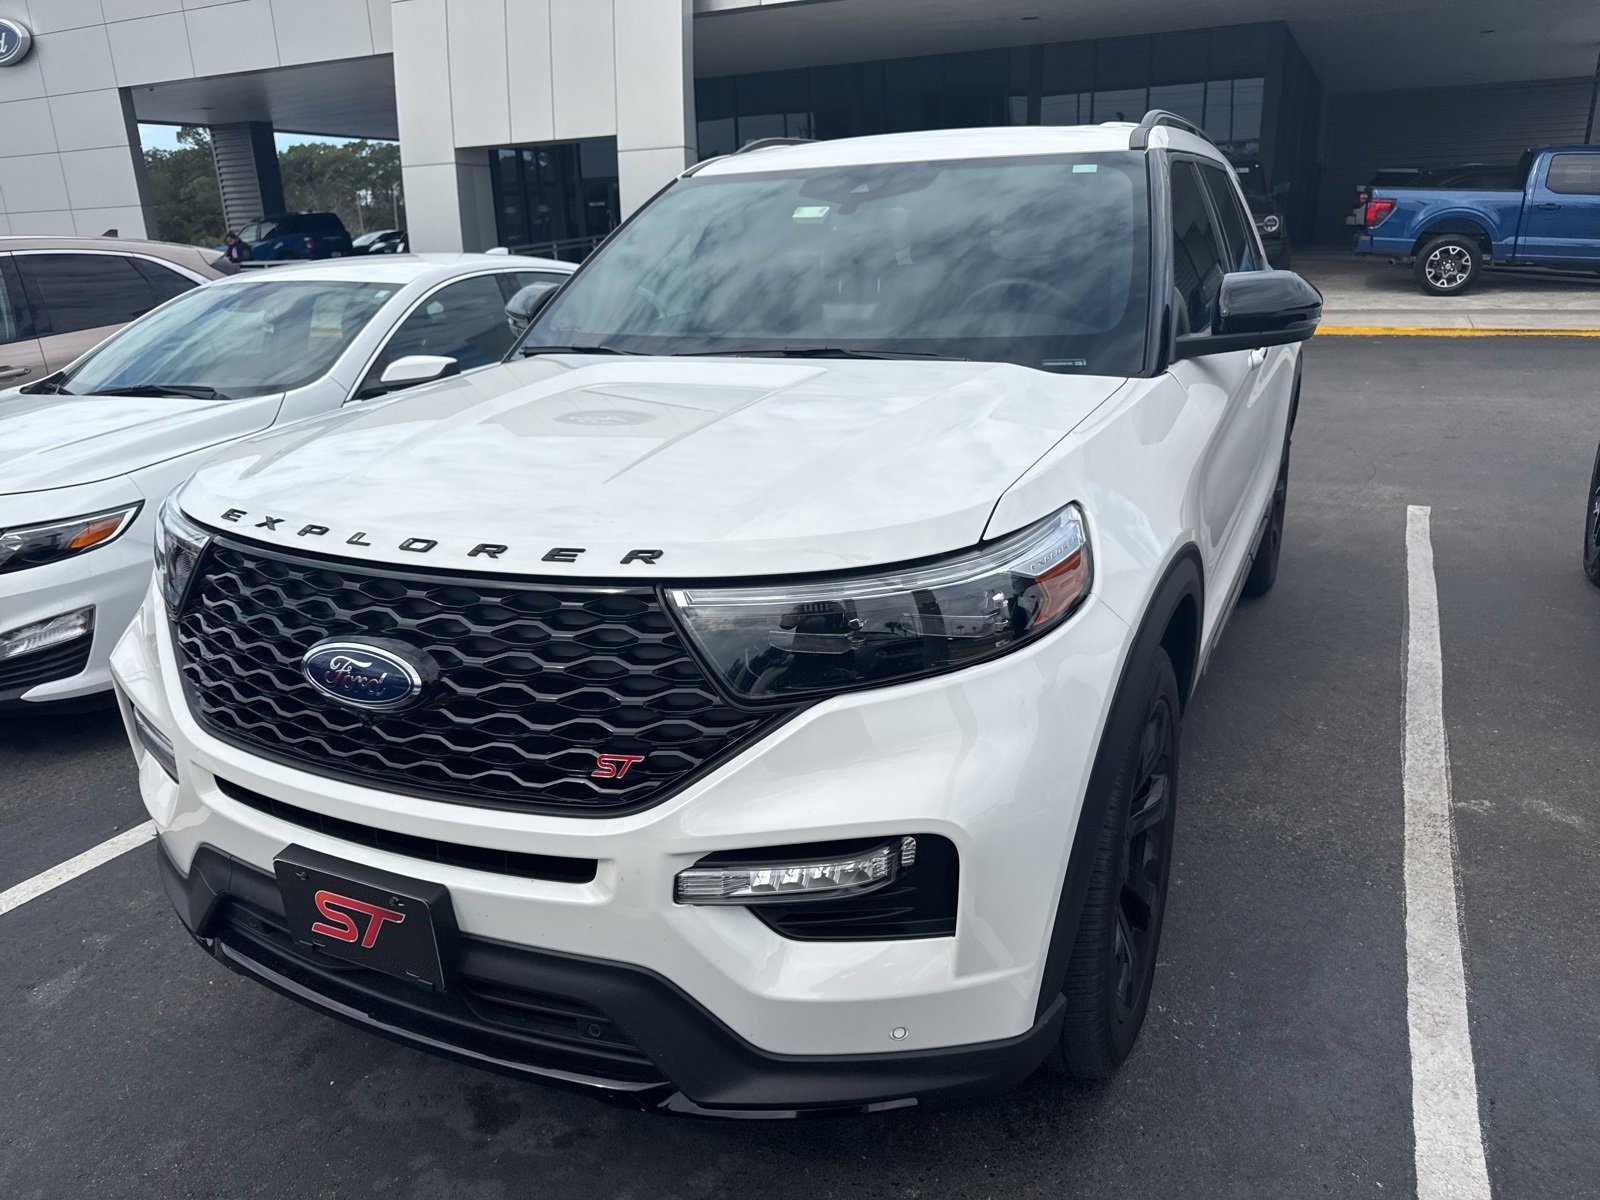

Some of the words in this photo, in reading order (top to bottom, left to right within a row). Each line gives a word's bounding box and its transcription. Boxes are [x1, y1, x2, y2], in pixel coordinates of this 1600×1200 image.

[220, 508, 664, 565] EXPLORER
[325, 656, 387, 696] Ford
[591, 753, 645, 779] ST
[311, 889, 406, 949] ST
